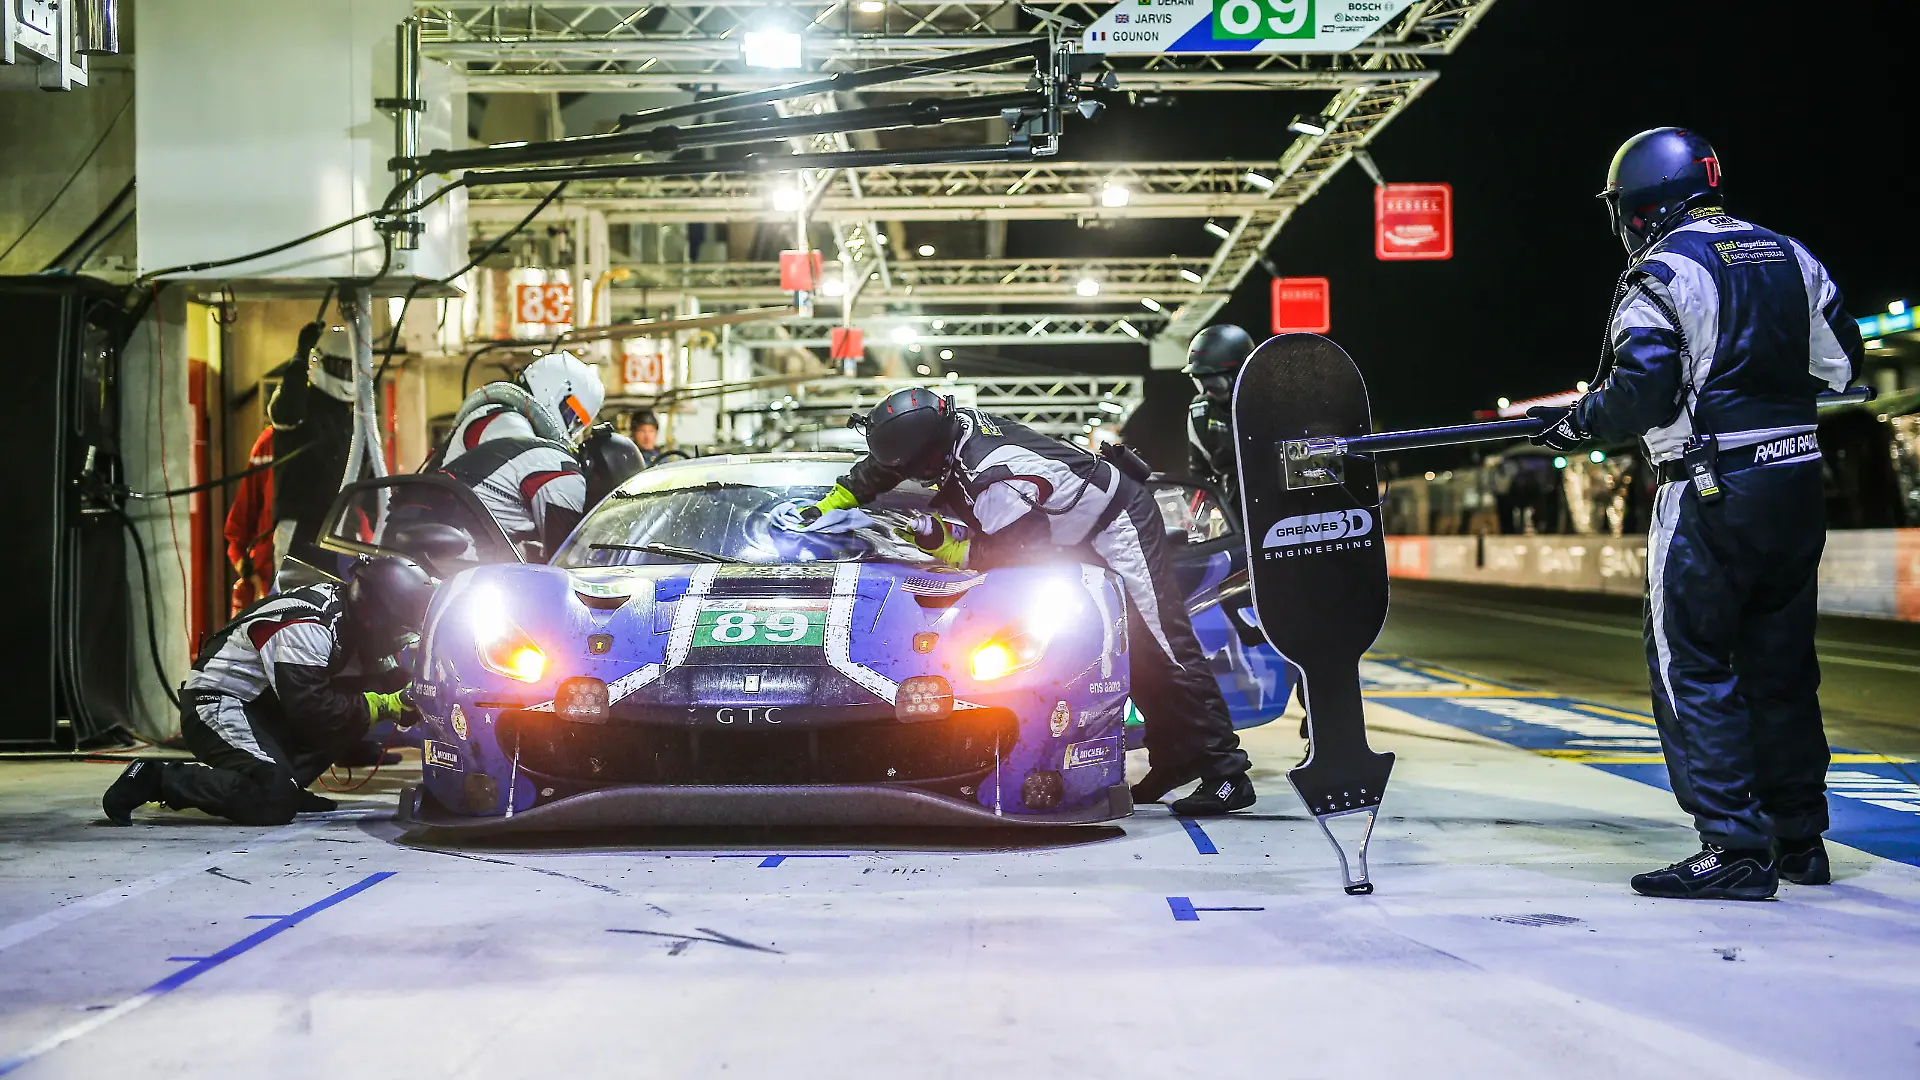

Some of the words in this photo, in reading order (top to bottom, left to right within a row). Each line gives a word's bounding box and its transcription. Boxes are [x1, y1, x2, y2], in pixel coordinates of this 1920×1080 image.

[1348, 2, 1381, 11] BOSCH
[1135, 13, 1172, 24] JARVIS
[1220, 0, 1308, 35] 89
[1344, 13, 1380, 22] brembo
[1112, 31, 1159, 41] GOUNON
[1714, 241, 1736, 251] Risi
[522, 286, 566, 323] 83
[1754, 437, 1796, 463] RACING
[1276, 521, 1338, 538] GREAVES
[1264, 539, 1373, 561] ENGINEERING
[711, 611, 809, 643] 89
[716, 707, 782, 724] GTC
[1218, 782, 1232, 799] OMP
[1690, 856, 1717, 873] OMP
